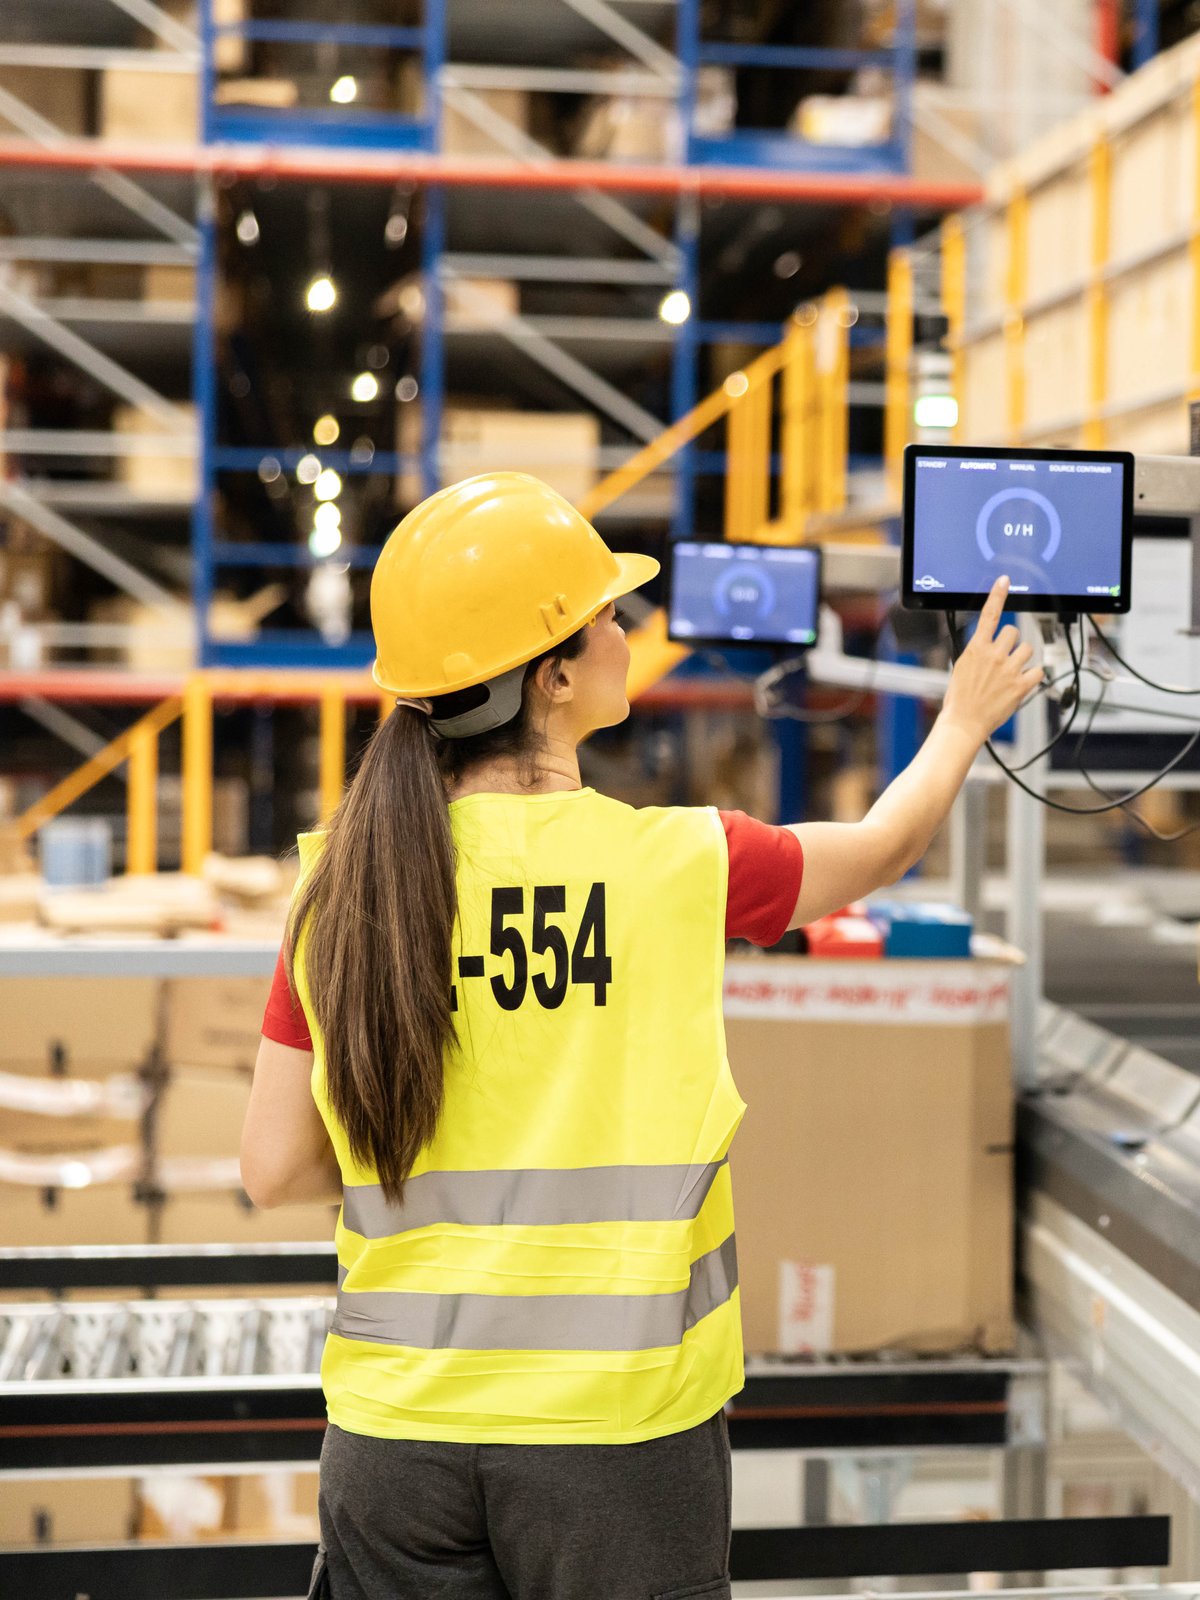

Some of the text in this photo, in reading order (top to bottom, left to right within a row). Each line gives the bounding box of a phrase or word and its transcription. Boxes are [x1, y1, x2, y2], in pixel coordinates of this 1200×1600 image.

[917, 460, 947, 469] STANDBY
[959, 461, 997, 471] AUTOMATIC
[1048, 464, 1112, 474] SOURCE CONTAINER
[451, 882, 612, 1012] -554
